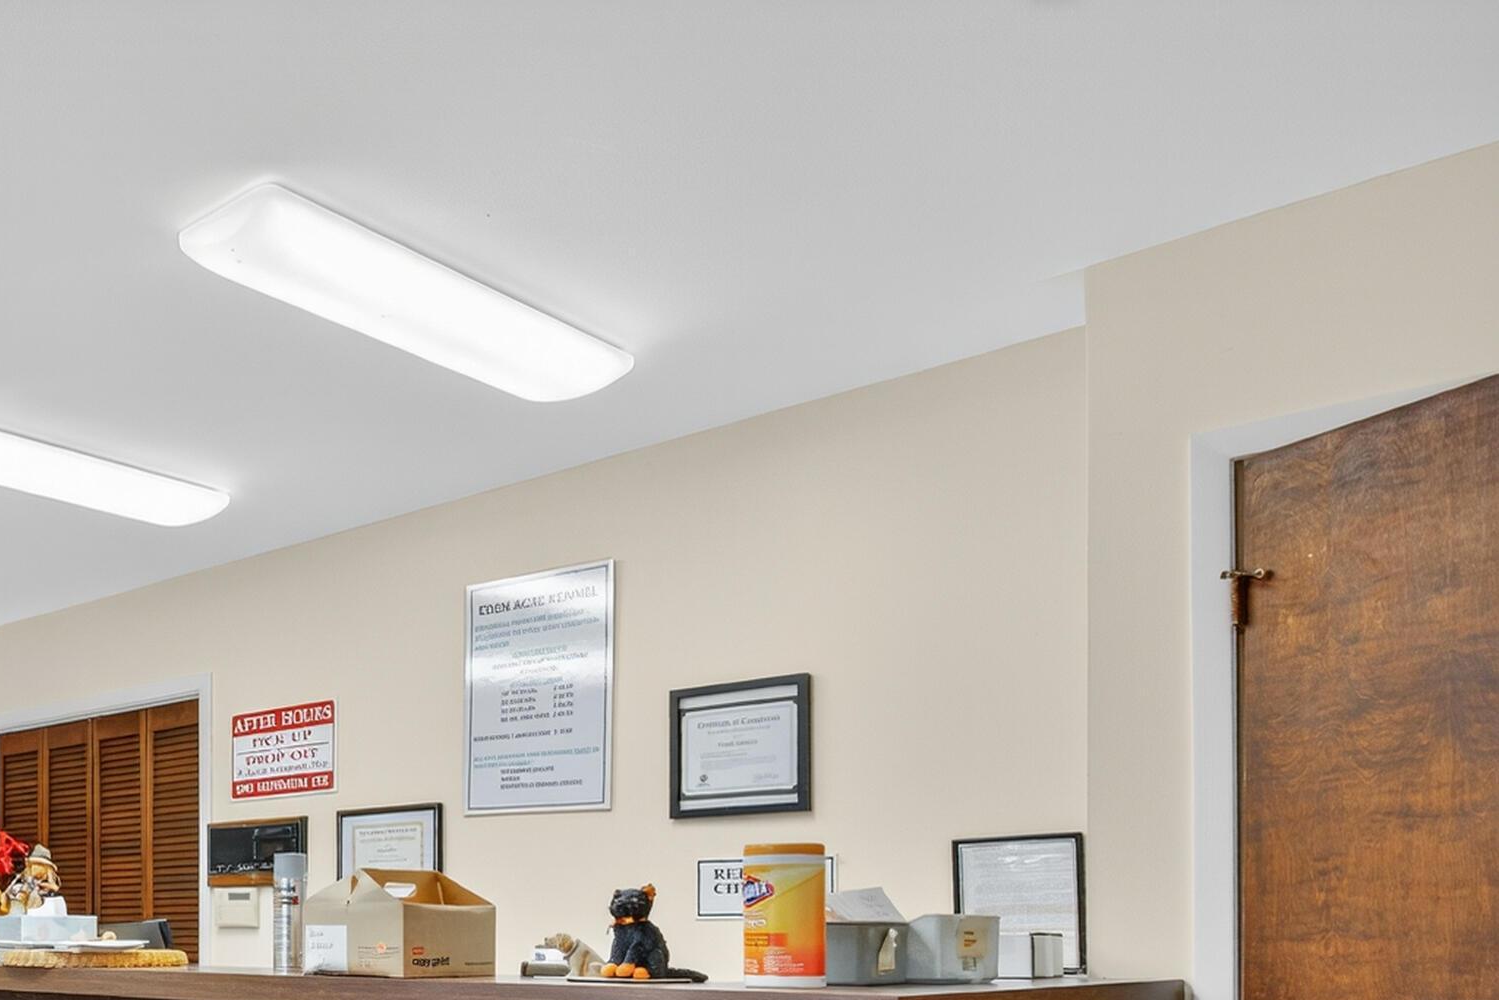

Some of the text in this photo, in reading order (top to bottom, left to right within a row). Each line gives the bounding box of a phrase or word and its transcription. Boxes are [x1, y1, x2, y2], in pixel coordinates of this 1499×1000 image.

[234, 705, 332, 734] AFTER HOURS
[252, 729, 312, 748] PICK UP
[245, 748, 318, 766] DROP OFF
